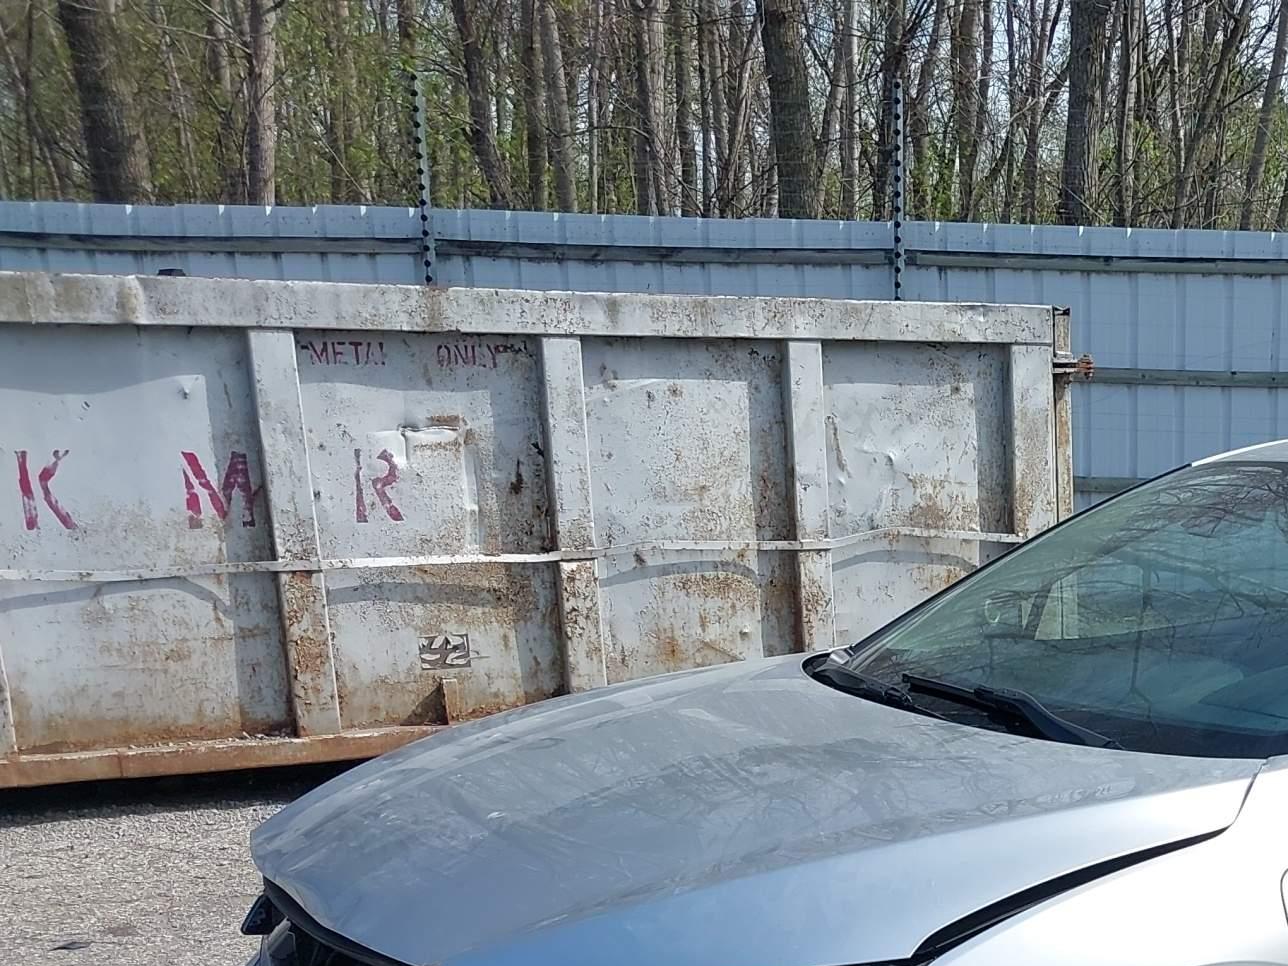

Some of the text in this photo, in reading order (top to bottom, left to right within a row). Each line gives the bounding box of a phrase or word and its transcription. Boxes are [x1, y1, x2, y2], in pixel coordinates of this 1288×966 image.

[14, 448, 405, 530] K M R
